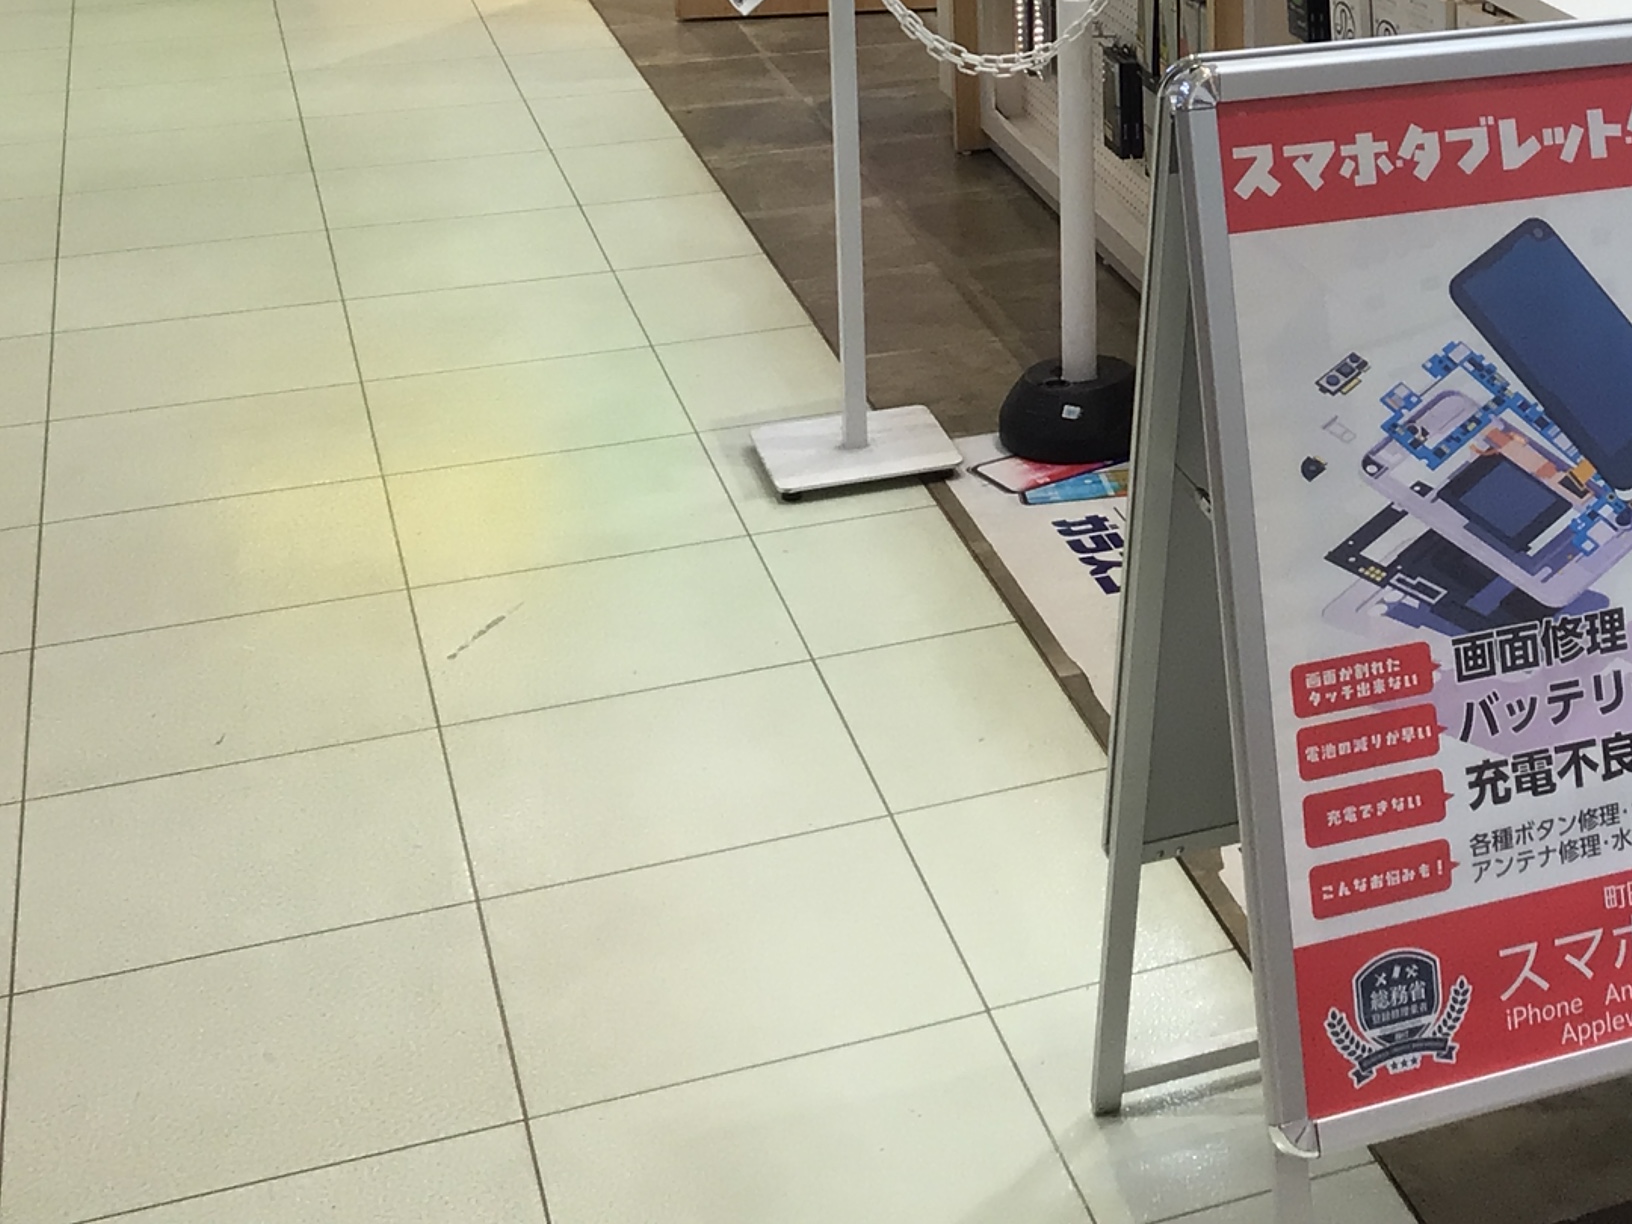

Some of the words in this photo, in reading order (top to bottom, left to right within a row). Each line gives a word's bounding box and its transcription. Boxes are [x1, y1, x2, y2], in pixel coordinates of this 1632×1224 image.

[1452, 607, 1628, 684] 画面修理
[1304, 657, 1402, 690] 画面が割れた
[1308, 673, 1419, 707] タッチ出来ない
[1326, 794, 1423, 827] 充電できない
[1370, 980, 1427, 1011] 総務省
[1506, 995, 1584, 1031] iPhone
